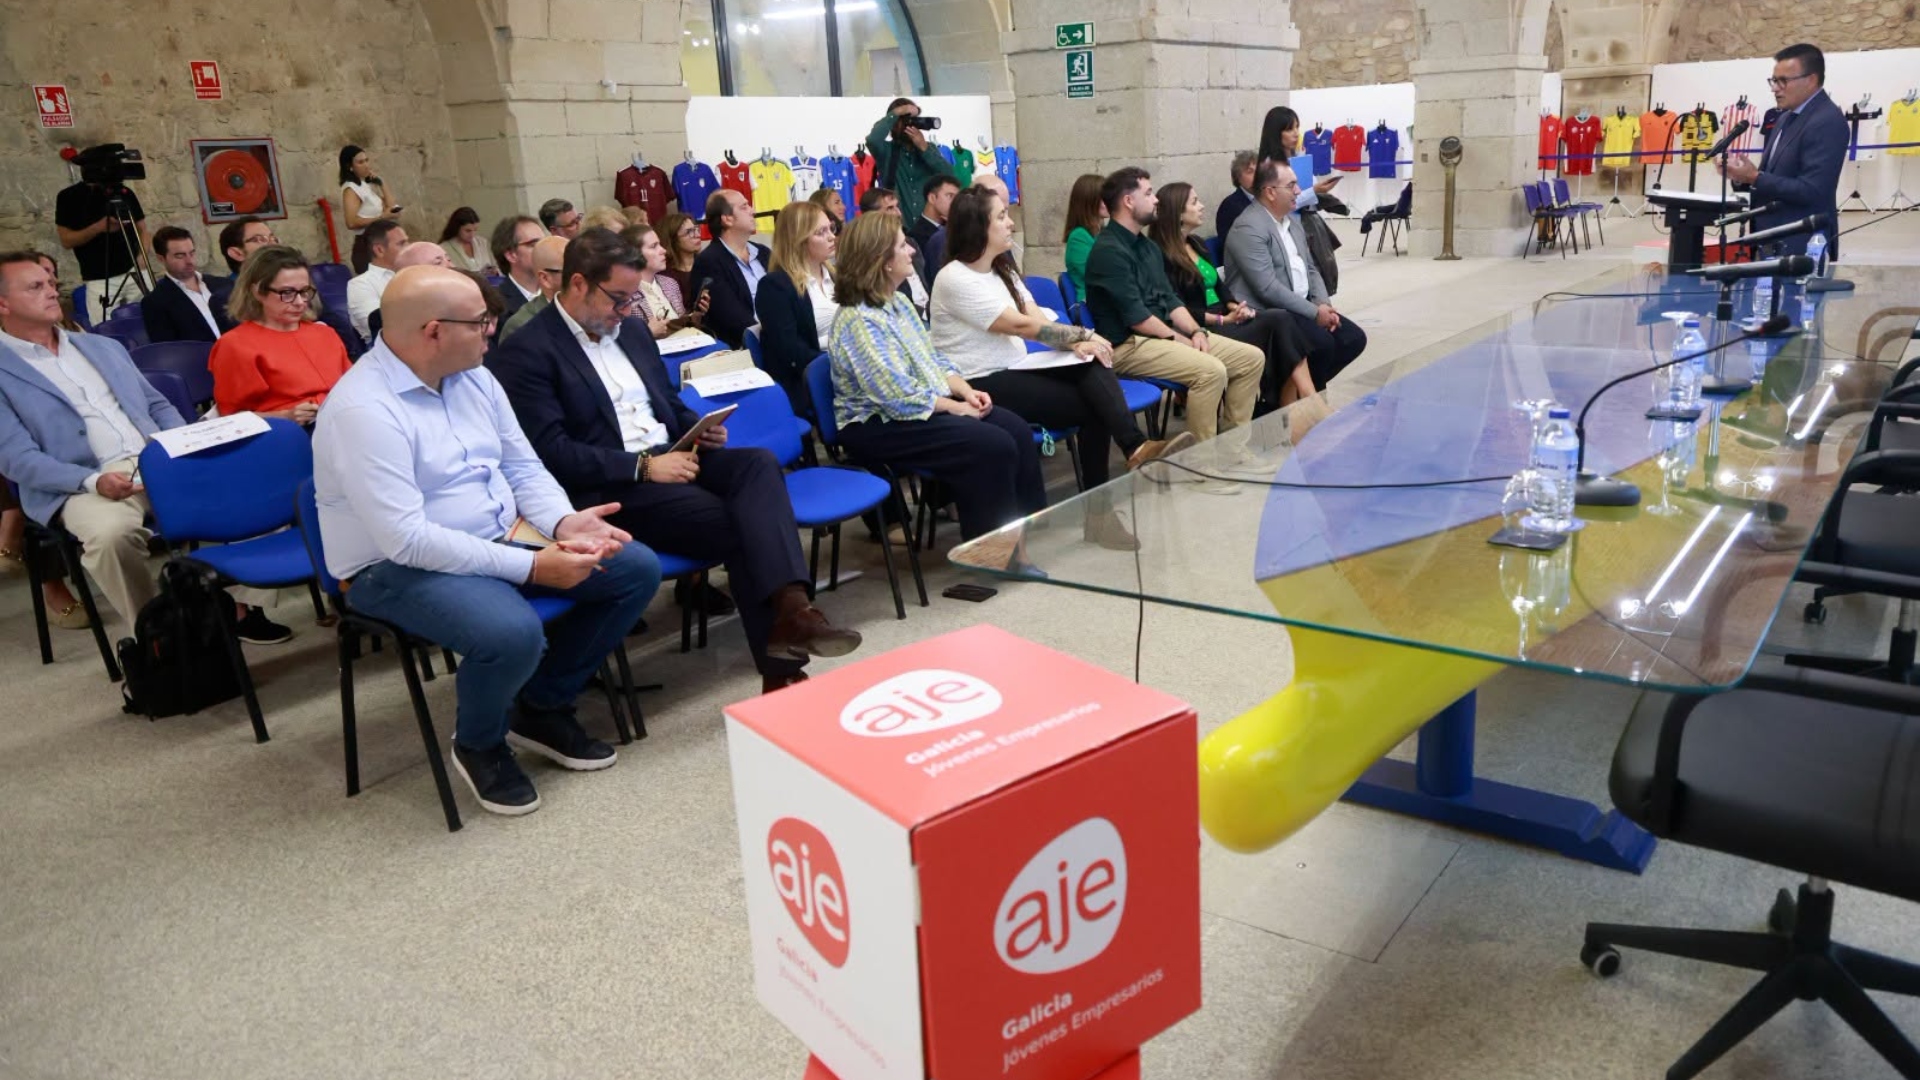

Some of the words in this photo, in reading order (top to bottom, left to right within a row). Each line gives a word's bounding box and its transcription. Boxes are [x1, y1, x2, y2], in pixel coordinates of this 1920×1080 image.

[640, 189, 648, 202] 11
[833, 180, 843, 190] 15
[854, 680, 985, 733] aje
[905, 729, 985, 764] Galicia
[922, 742, 998, 778] Jóvenes
[994, 701, 1101, 746] Empresarios
[772, 839, 846, 942] aje
[1006, 858, 1117, 960] aje
[776, 937, 818, 983] Galicia
[1002, 991, 1073, 1040] Galicia
[1002, 1023, 1068, 1074] Jóvenes
[1071, 968, 1164, 1029] Empresarios
